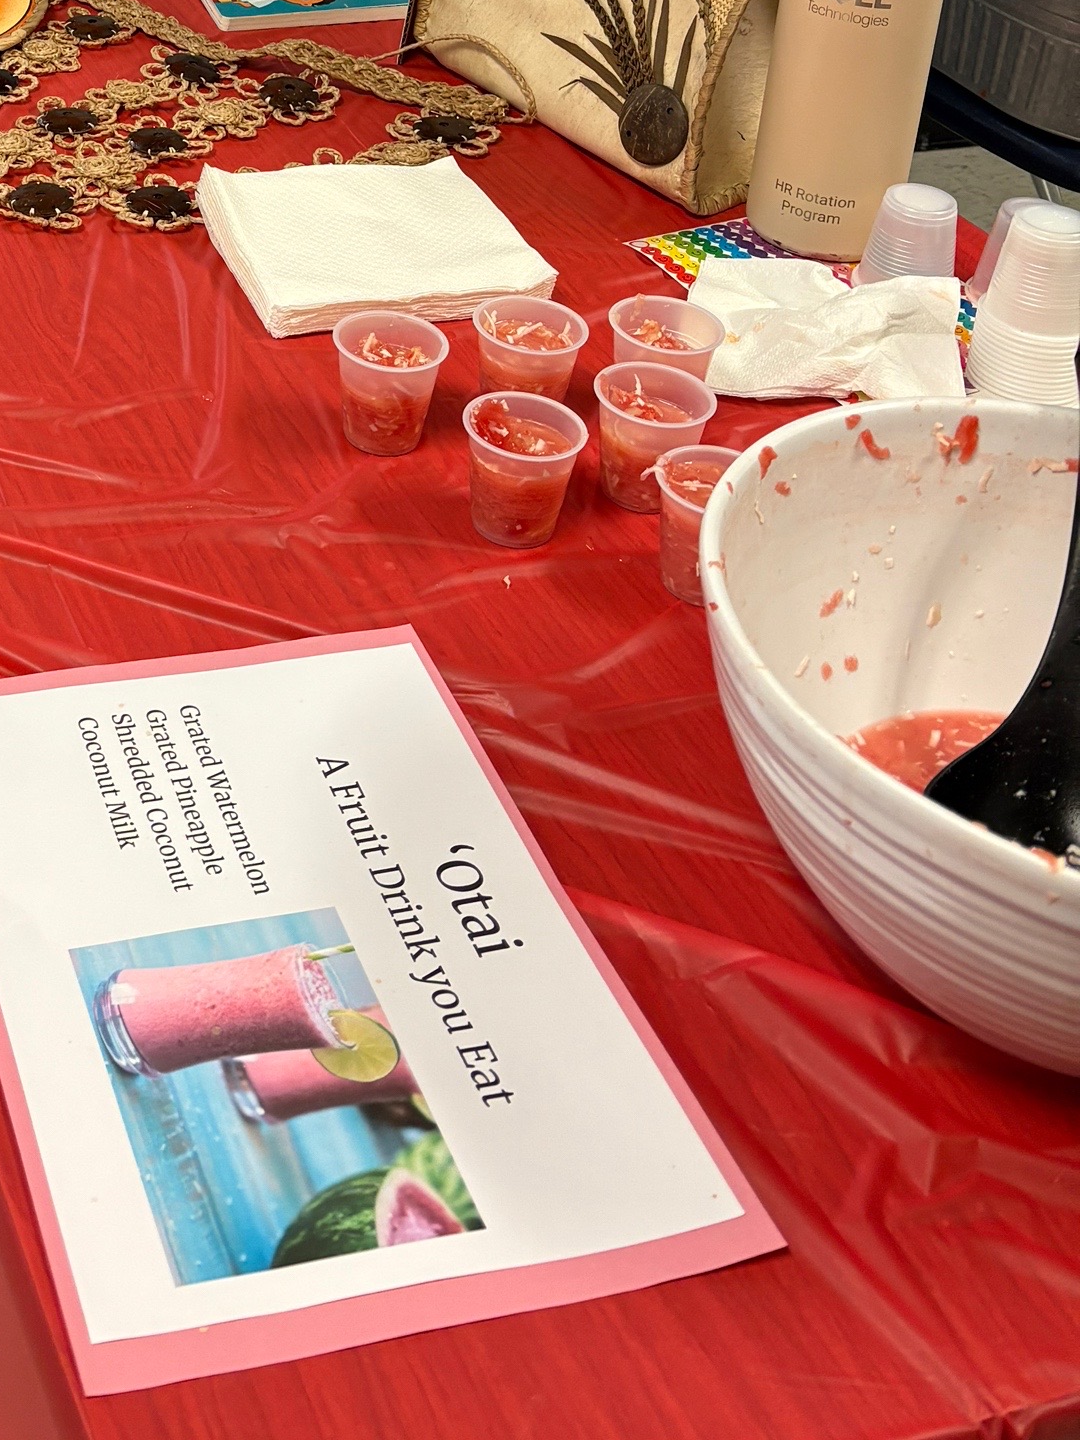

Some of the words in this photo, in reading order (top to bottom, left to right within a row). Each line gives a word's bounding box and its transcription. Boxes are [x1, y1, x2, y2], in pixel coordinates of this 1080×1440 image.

[774, 177, 794, 197] HR
[795, 185, 857, 211] Rotation
[781, 199, 842, 227] Program
[78, 716, 121, 798] Coconut
[105, 800, 141, 850] Milk
[111, 712, 164, 805] Shredded
[146, 807, 194, 893] Coconut
[145, 709, 189, 773] Grated
[170, 775, 225, 876] Pineapple
[179, 704, 224, 768] Grated
[206, 769, 271, 896] Watermelon
[316, 756, 350, 779] A
[329, 781, 390, 860] Fruit
[369, 862, 441, 963] Drink
[409, 965, 475, 1035] you
[456, 1040, 515, 1108] Eat
